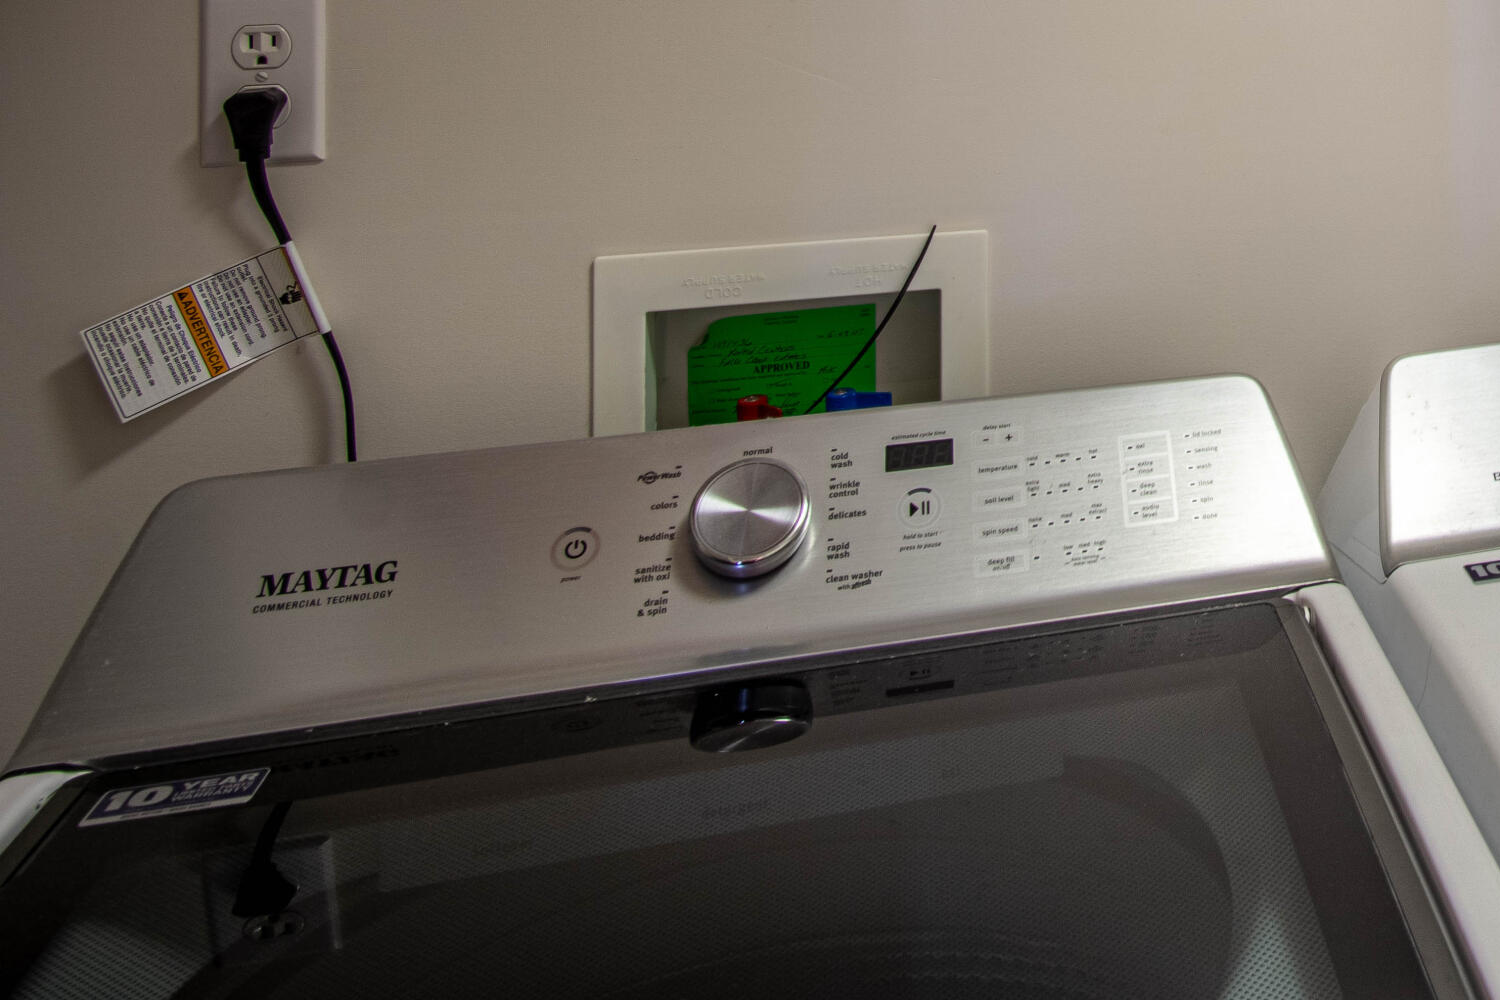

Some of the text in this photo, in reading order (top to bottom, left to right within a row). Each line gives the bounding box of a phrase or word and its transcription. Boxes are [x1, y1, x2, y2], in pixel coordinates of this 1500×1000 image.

[180, 298, 226, 373] ADVERTENCIA
[753, 360, 811, 374] APPROVED
[743, 446, 773, 457] normal
[831, 452, 849, 461] cold
[830, 460, 853, 469] wash
[977, 463, 1018, 474] temperature
[829, 480, 861, 490] wrinkle
[828, 488, 859, 499] control
[650, 500, 679, 511] colors
[984, 495, 1014, 505] soil level
[828, 509, 867, 521] delicates
[982, 525, 1019, 537] spin speed
[638, 531, 676, 543] bedding
[827, 542, 850, 553] rapid
[826, 550, 850, 561] wash
[987, 556, 1015, 566] deep fill
[635, 563, 672, 575] sanitize
[255, 560, 399, 599] MAYTAG
[633, 572, 671, 584] with oxi
[825, 569, 883, 584] clean washer
[252, 588, 394, 615] COMMERCIAL TECHNOLOGY
[643, 597, 669, 608] drain
[647, 606, 668, 617] spin
[103, 771, 260, 812] 10 YEAR
